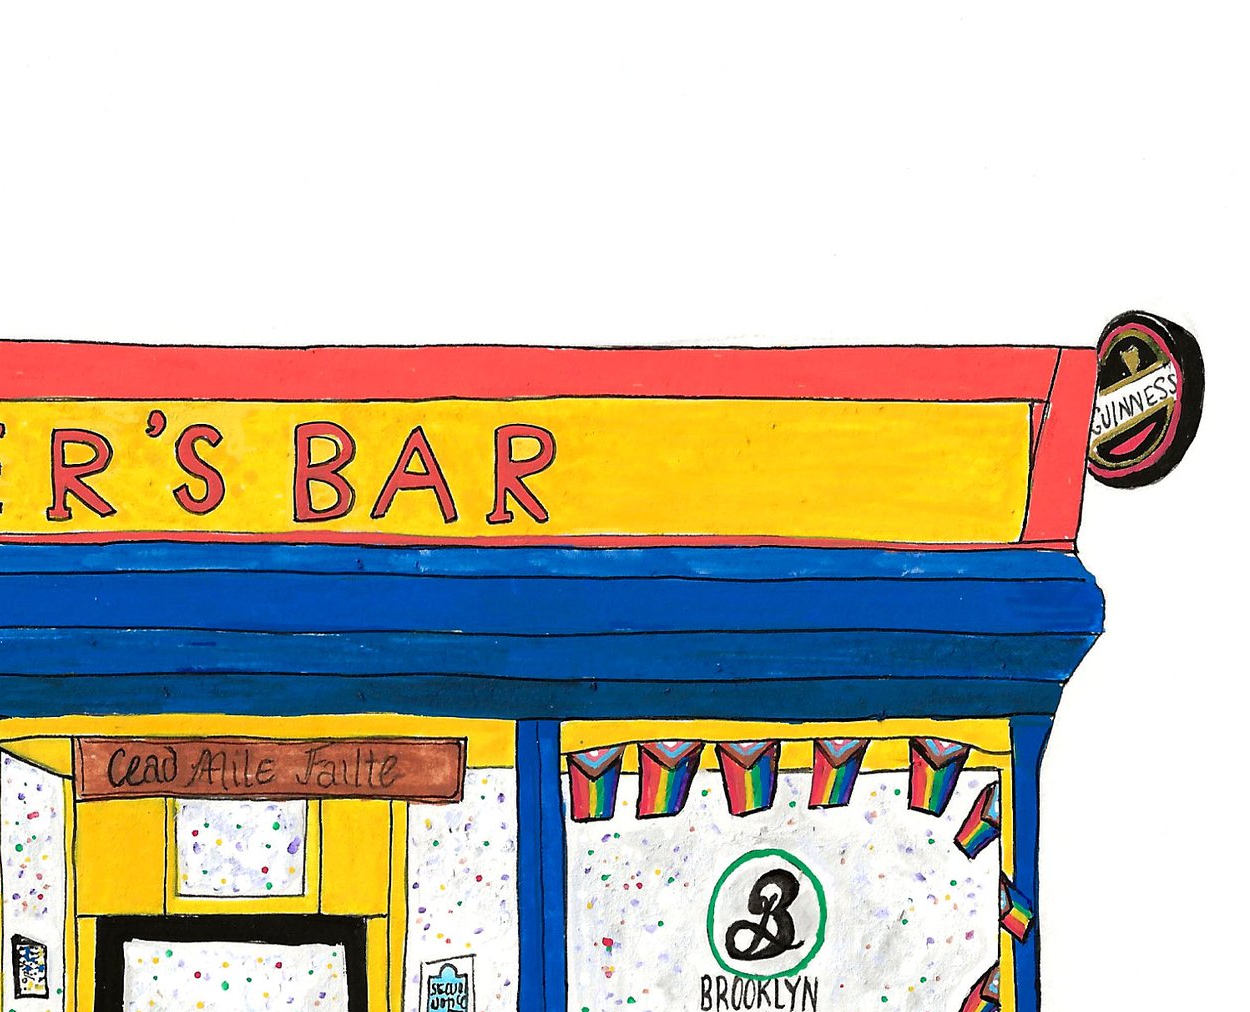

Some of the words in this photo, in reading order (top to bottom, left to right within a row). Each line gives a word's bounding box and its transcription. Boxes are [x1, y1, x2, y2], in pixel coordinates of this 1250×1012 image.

[1090, 373, 1177, 434] GUINNESS
[293, 421, 558, 524] BAR
[700, 974, 819, 1012] BROOKLYN
